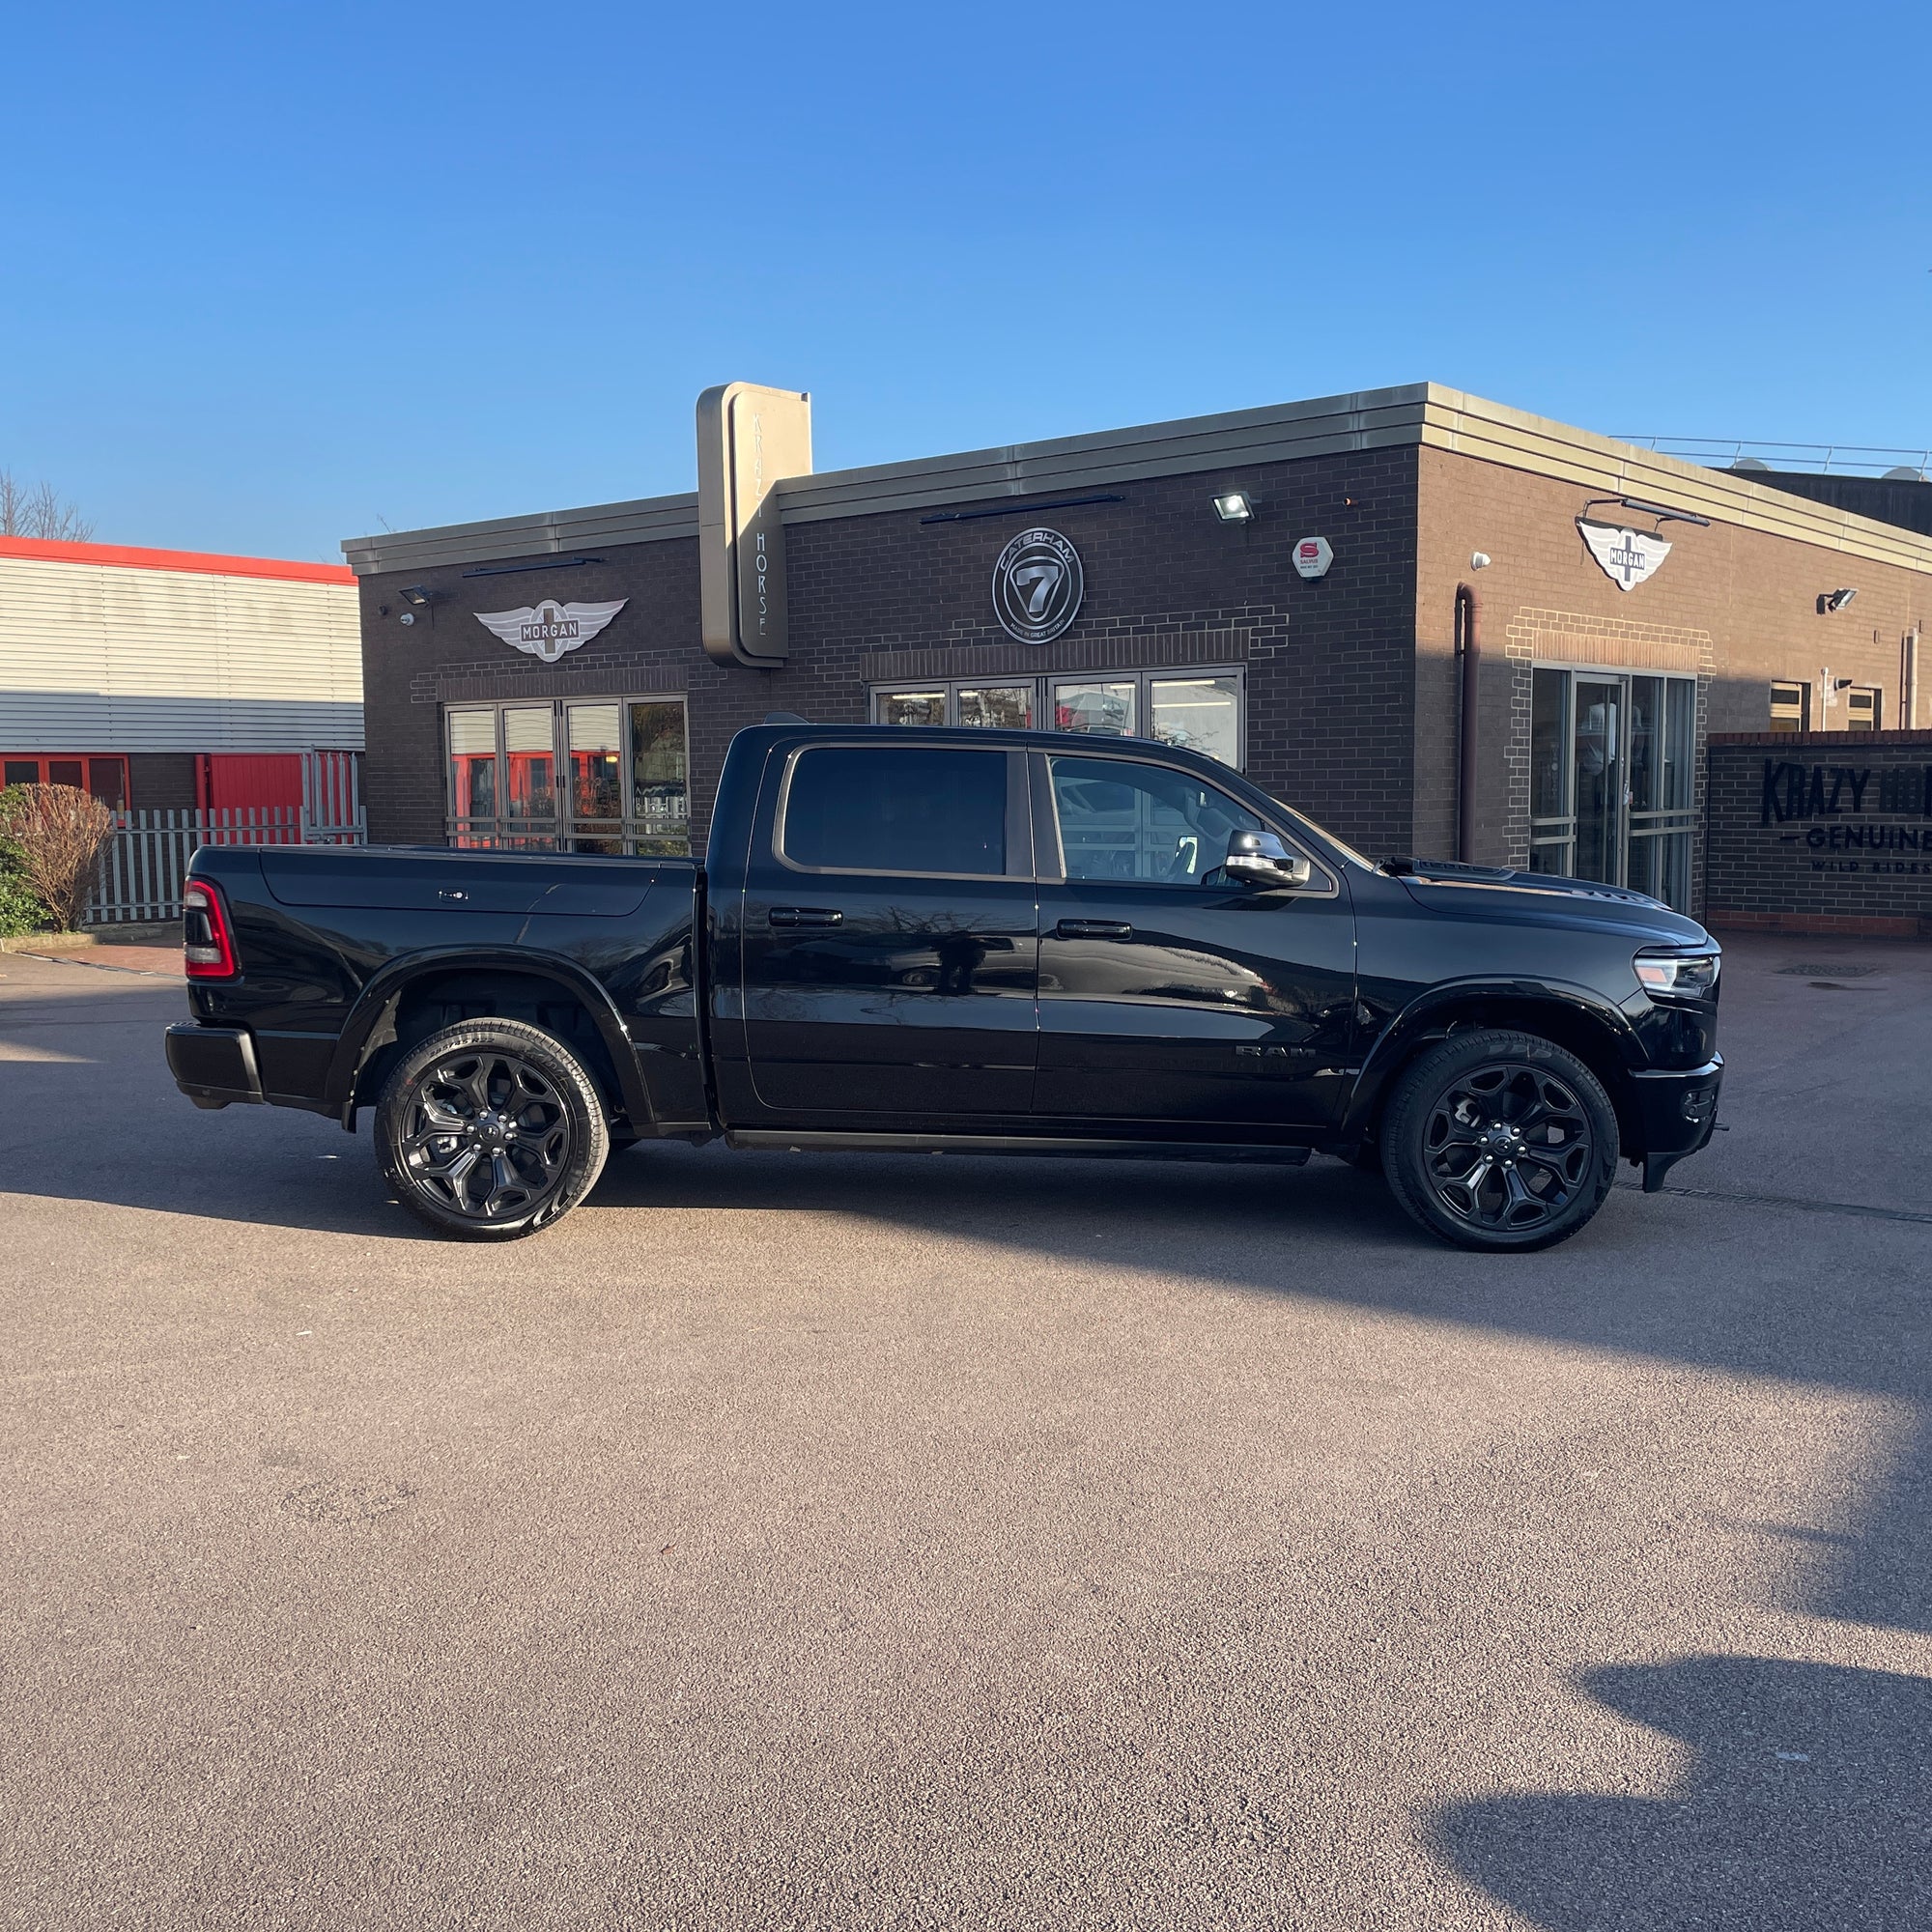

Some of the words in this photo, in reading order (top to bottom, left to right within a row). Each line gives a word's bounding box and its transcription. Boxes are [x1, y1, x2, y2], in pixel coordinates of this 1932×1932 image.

[1000, 531, 1075, 571] CATERHAM
[1610, 549, 1644, 568] MORGAN
[755, 532, 767, 636] HORSE
[1016, 565, 1059, 612] 7
[524, 623, 577, 639] MORGAN
[1761, 758, 1871, 827] KRAZY
[1811, 861, 1860, 872] WILD
[1872, 862, 1931, 874] RIDES
[1236, 1045, 1316, 1059] RAM
